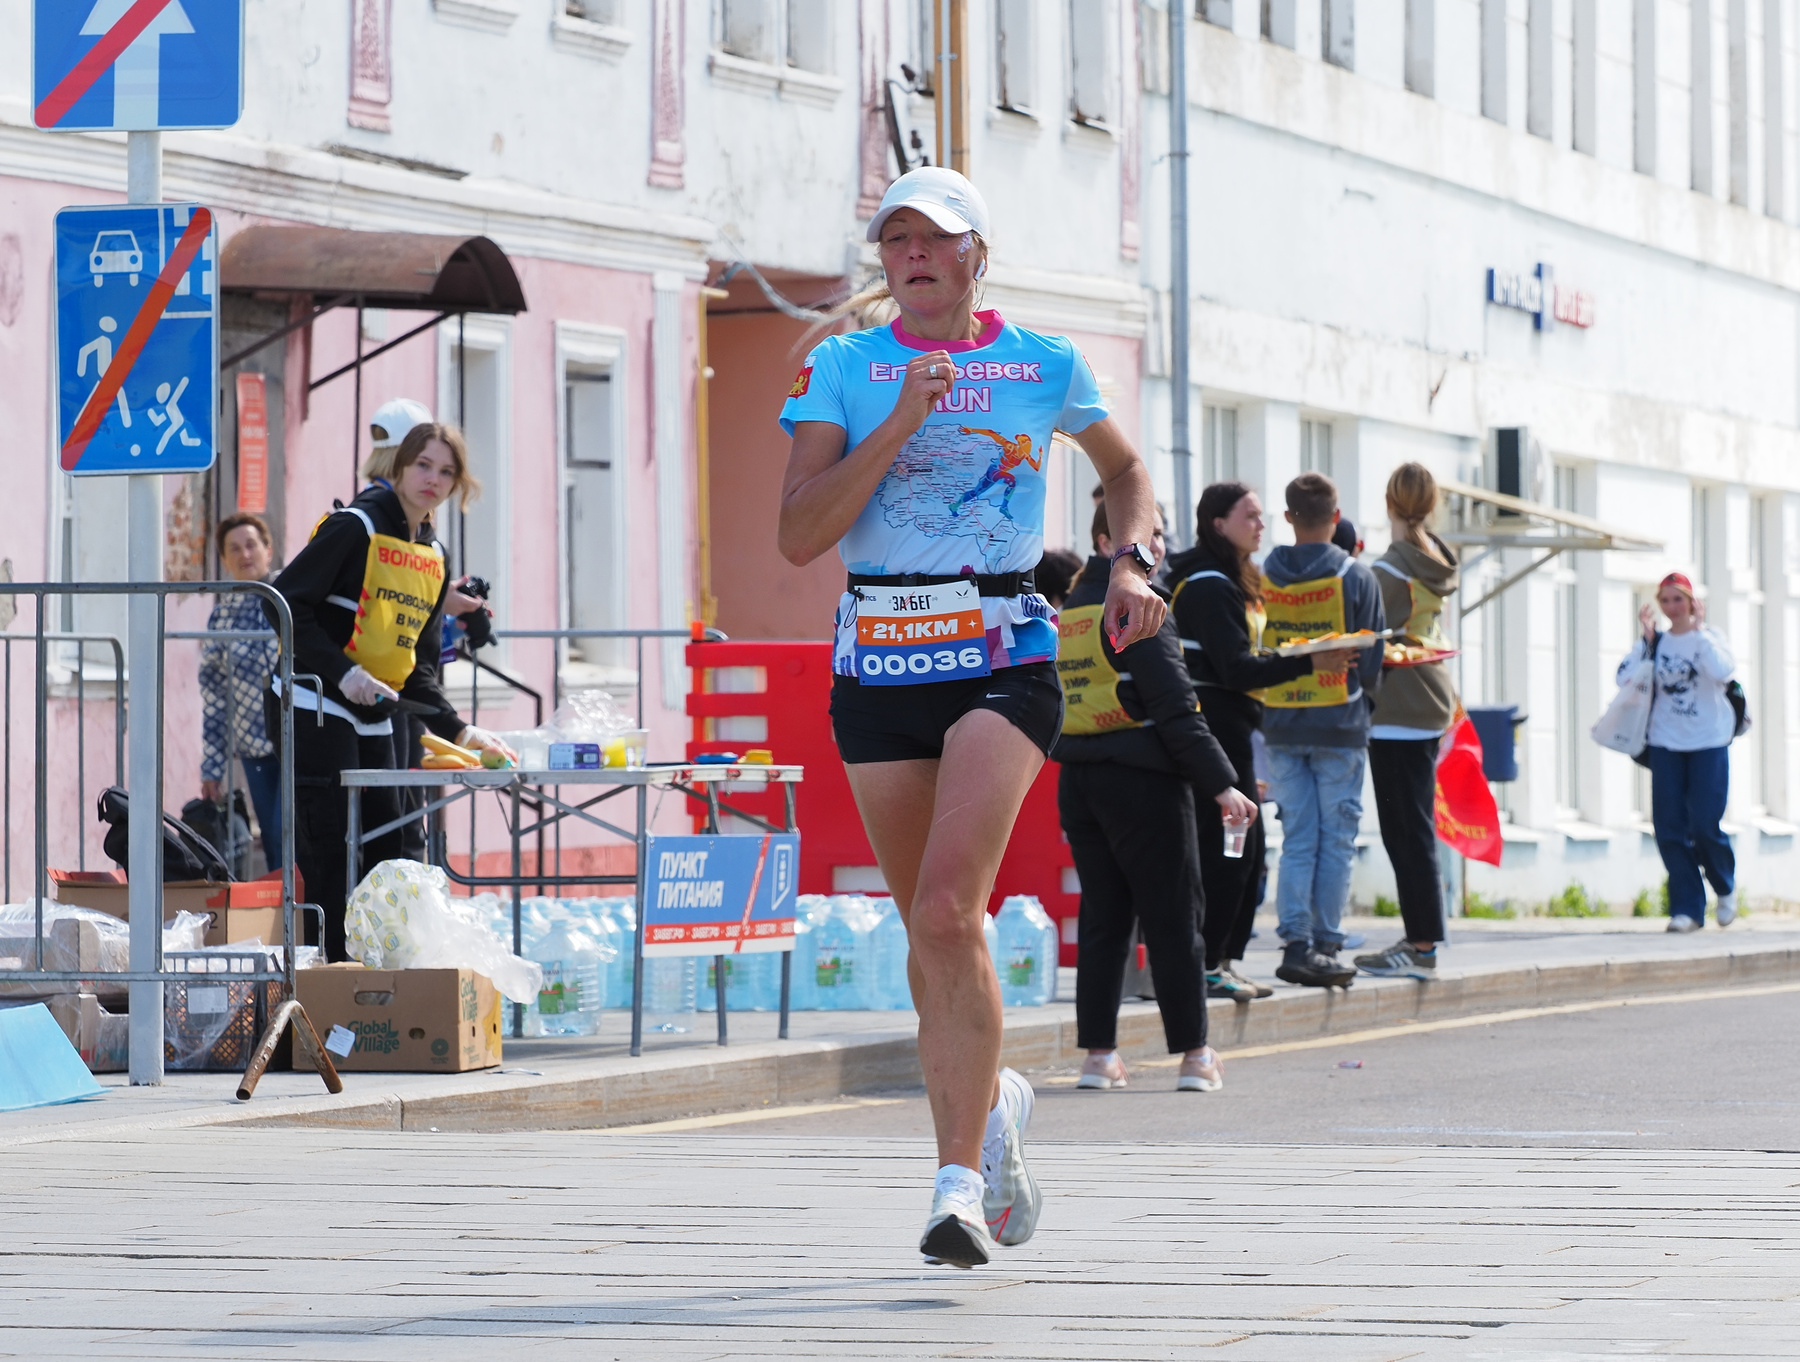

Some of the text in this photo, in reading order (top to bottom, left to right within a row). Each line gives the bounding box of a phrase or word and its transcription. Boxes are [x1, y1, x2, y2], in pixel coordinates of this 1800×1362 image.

[378, 546, 442, 580] ВОЛОНТЕ
[1264, 587, 1334, 606] ОЛОНТЕР
[862, 647, 983, 676] 00036
[658, 851, 708, 879] ПУНКТ
[657, 880, 724, 909] ПИТАНИЯ
[347, 1018, 392, 1036] Global
[354, 1036, 400, 1054] Village
